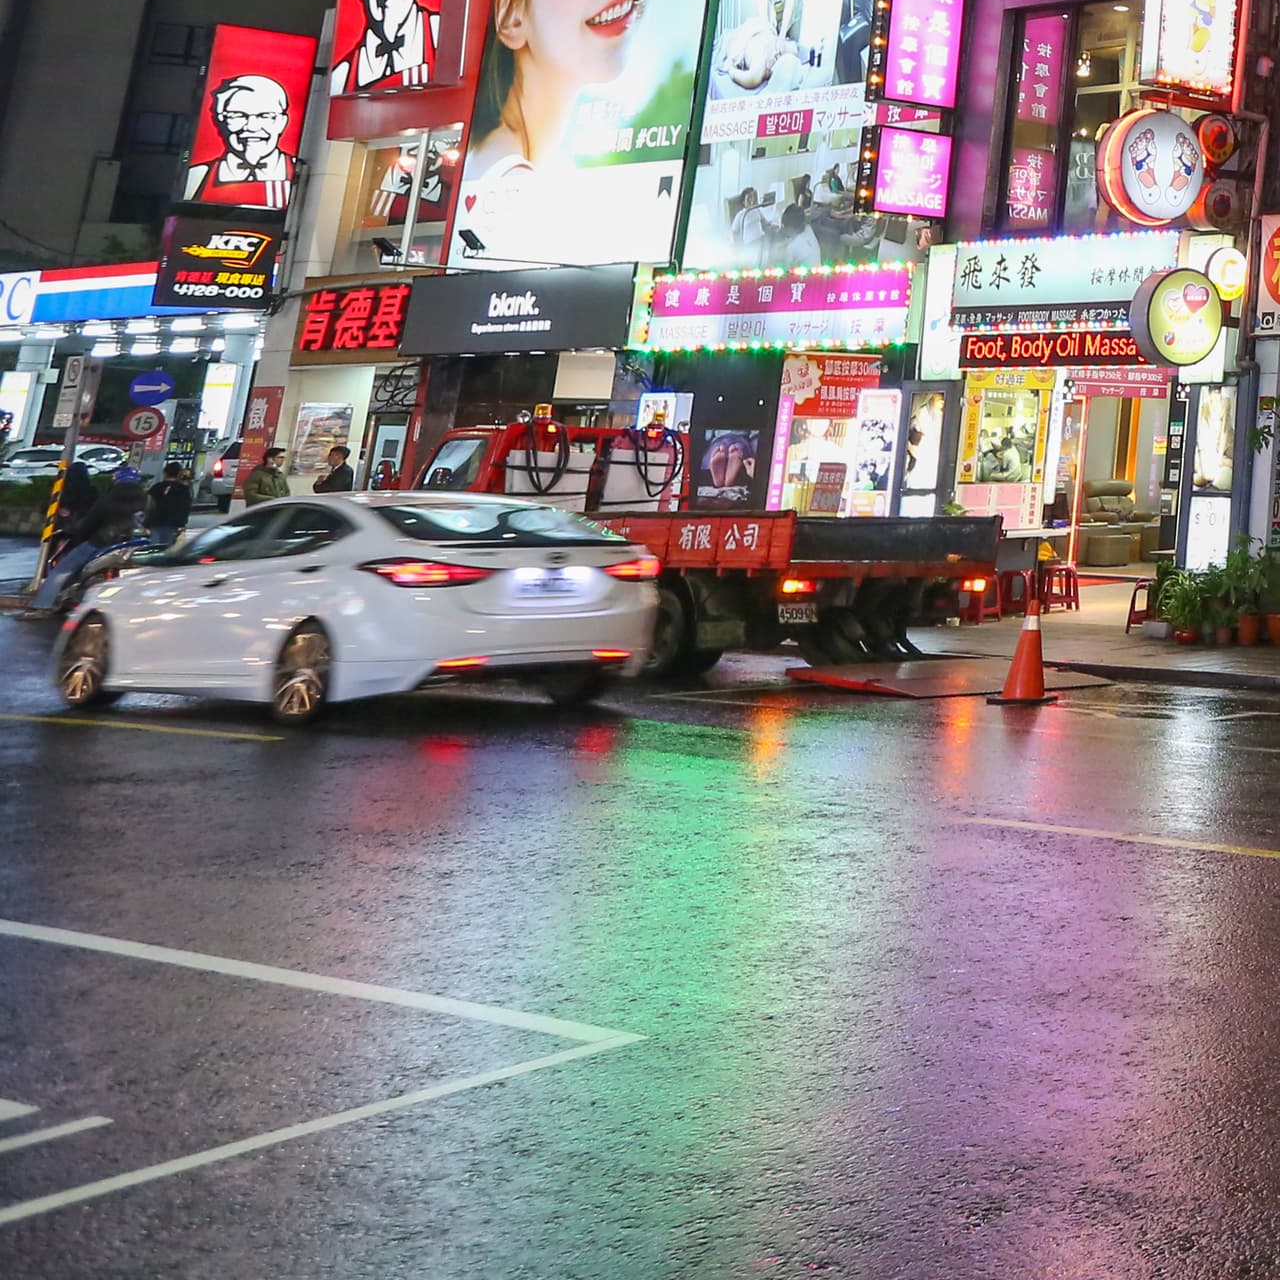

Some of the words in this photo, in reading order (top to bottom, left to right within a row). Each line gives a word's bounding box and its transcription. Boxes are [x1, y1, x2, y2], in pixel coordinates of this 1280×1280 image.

[703, 120, 754, 139] MASSAGE
[766, 113, 804, 135] 발안마
[636, 124, 681, 151] #CILY
[877, 191, 943, 210] MASSAGE
[207, 235, 259, 251] KFC
[960, 252, 1042, 291] 飛來發
[172, 284, 264, 299] 4128-000
[665, 282, 806, 308] 健康是個寶
[488, 290, 540, 318] blank.
[301, 283, 411, 351] 肯德基
[660, 324, 708, 339] MASSAGE
[727, 320, 766, 338] 발안마
[967, 333, 1007, 361] Foot,
[1011, 334, 1054, 364] Body
[1056, 333, 1080, 357] Oil
[1085, 334, 1145, 362] Massa
[134, 415, 153, 431] 15
